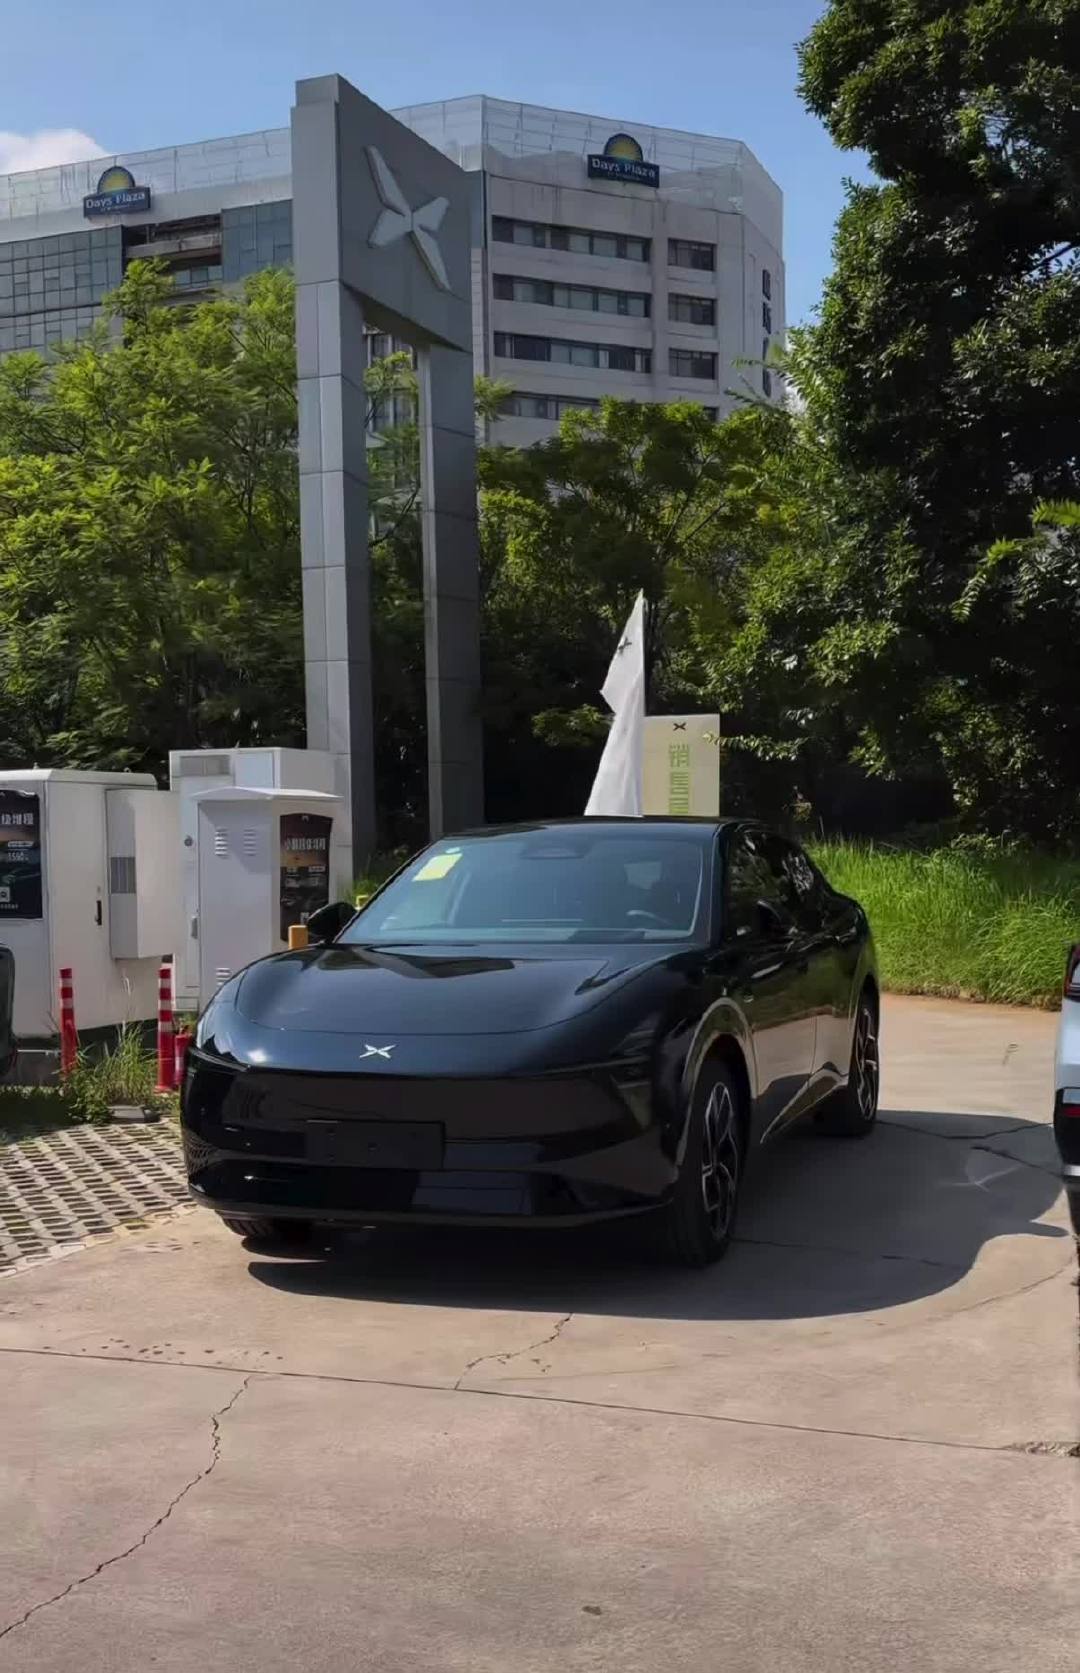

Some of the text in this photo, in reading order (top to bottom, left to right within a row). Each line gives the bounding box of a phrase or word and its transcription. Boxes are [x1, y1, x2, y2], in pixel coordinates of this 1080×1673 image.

[592, 158, 620, 171] Days
[625, 163, 656, 178] Plaza
[86, 197, 112, 209] Days
[115, 192, 145, 204] Plaza
